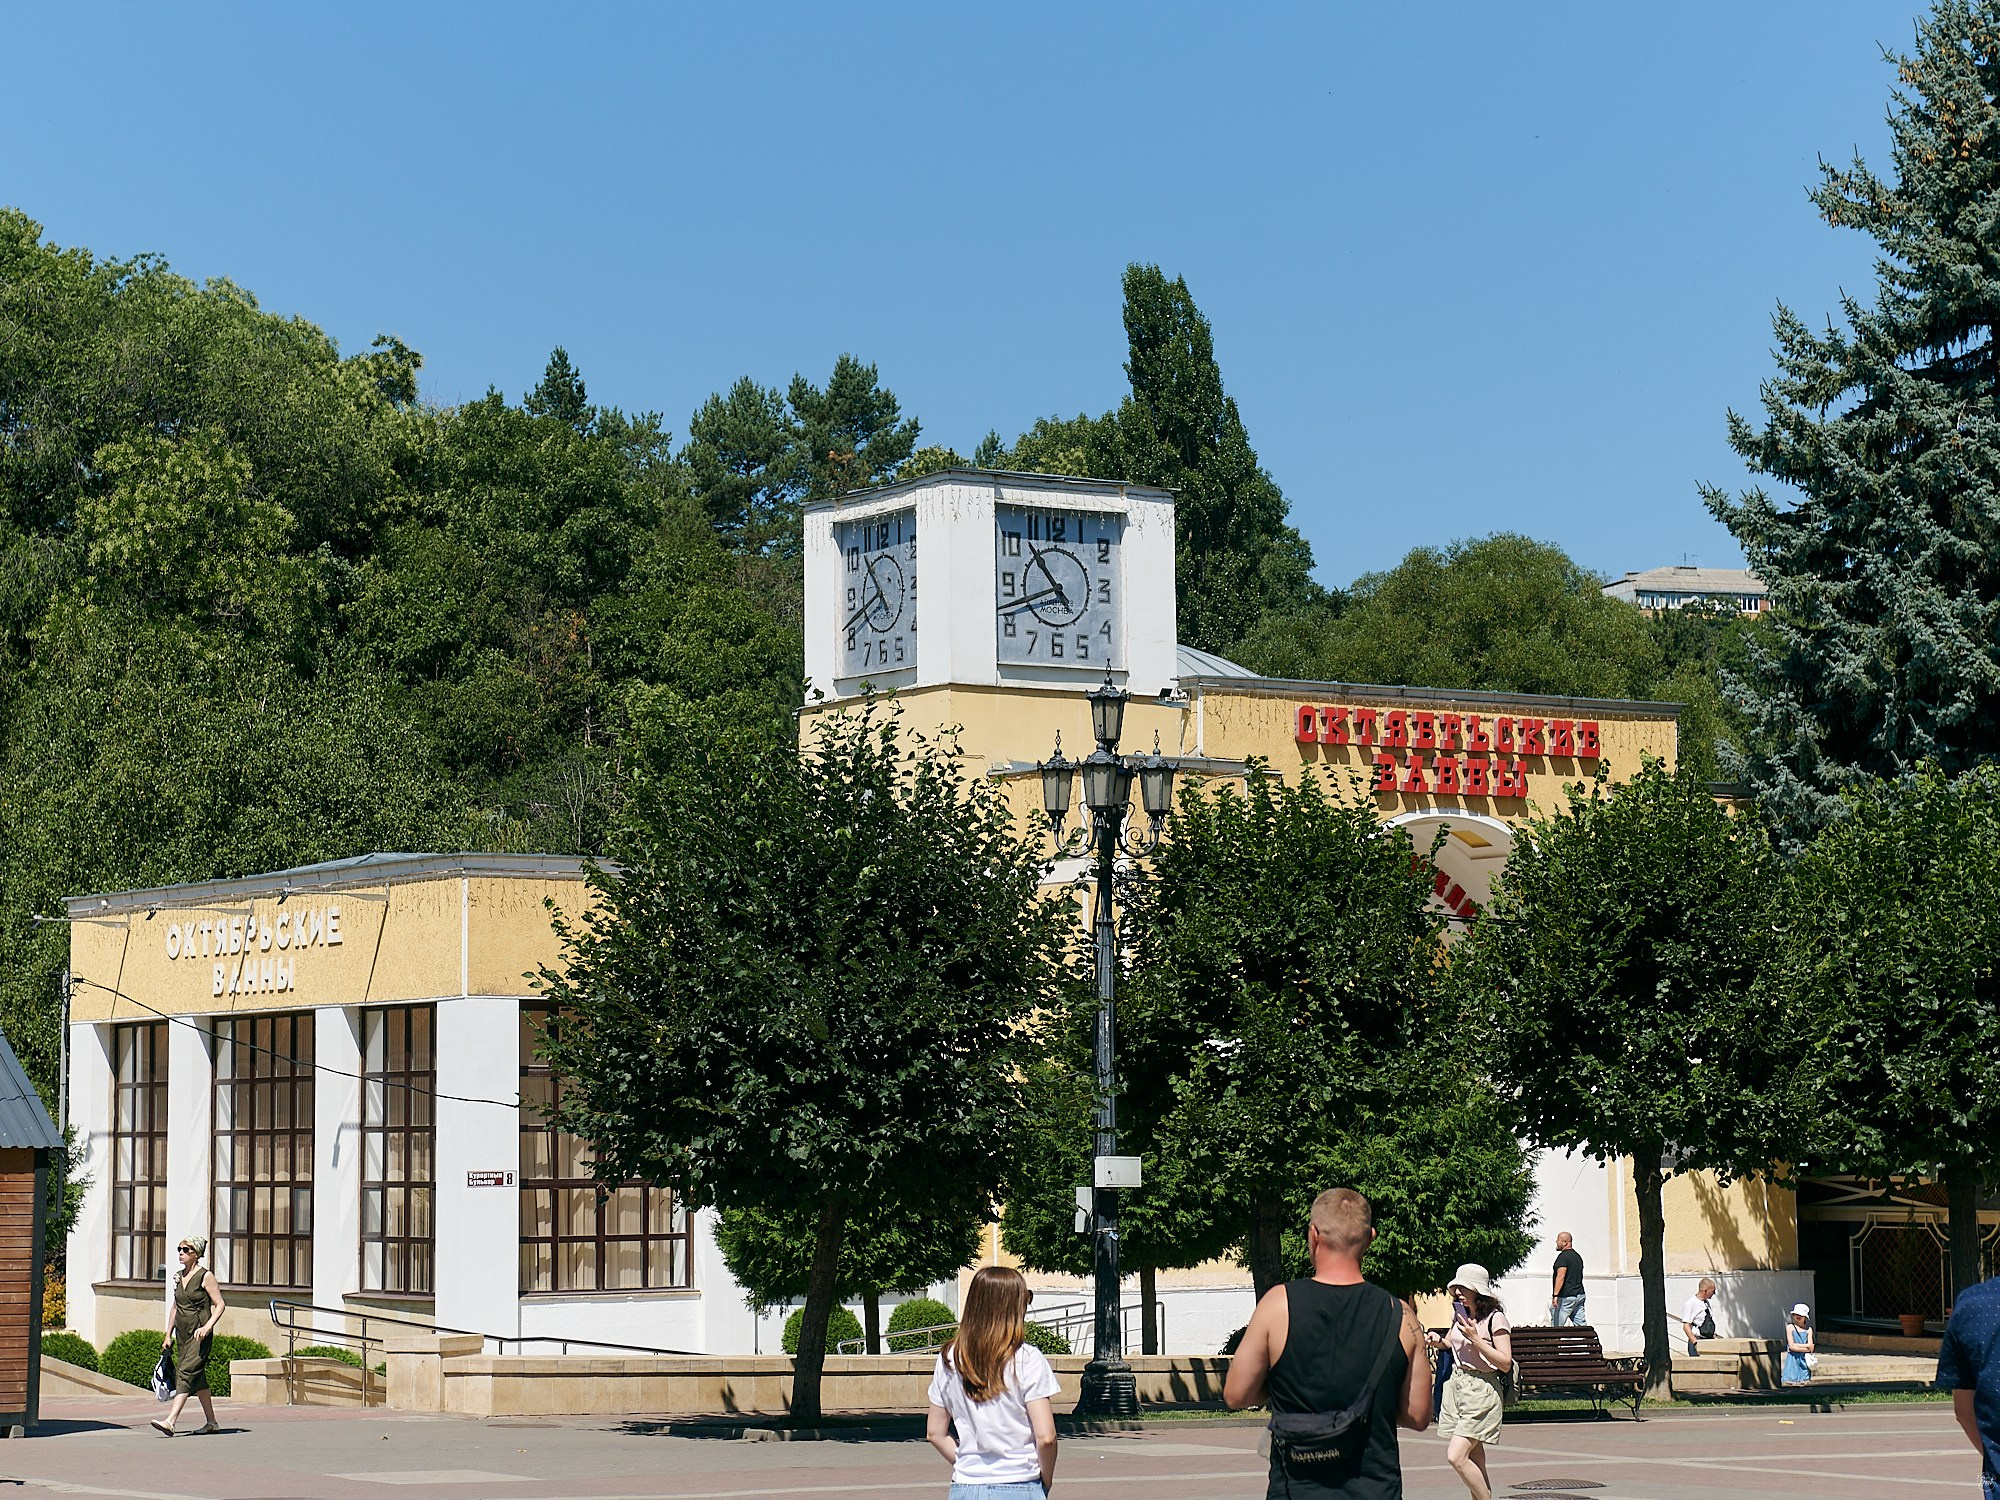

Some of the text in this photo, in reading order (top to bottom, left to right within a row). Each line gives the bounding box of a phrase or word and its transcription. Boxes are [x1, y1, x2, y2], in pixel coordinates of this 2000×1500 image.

[877, 522, 889, 550] 12
[1046, 516, 1066, 543] 12
[1079, 519, 1083, 544] 1
[1001, 531, 1021, 557] 10
[1097, 538, 1110, 564] 2
[847, 547, 859, 573] 10
[1003, 572, 1015, 597] 9
[1098, 579, 1111, 604] 3
[1004, 613, 1016, 637] 8
[1100, 619, 1112, 644] 4
[848, 627, 856, 651] 8
[880, 640, 888, 664] 6
[895, 637, 903, 661] 5
[1025, 630, 1038, 655] 7
[1051, 632, 1064, 658] 6
[1076, 634, 1089, 660] 5
[864, 641, 871, 667] 7
[1295, 705, 1599, 757] ОКТЯБРЬСКИЕ
[1373, 753, 1528, 798] ВАННЫ
[167, 907, 342, 959] ОКТЯБРЬСКИЕ
[213, 957, 294, 997] ВАННЫ
[507, 1173, 512, 1184] 8
